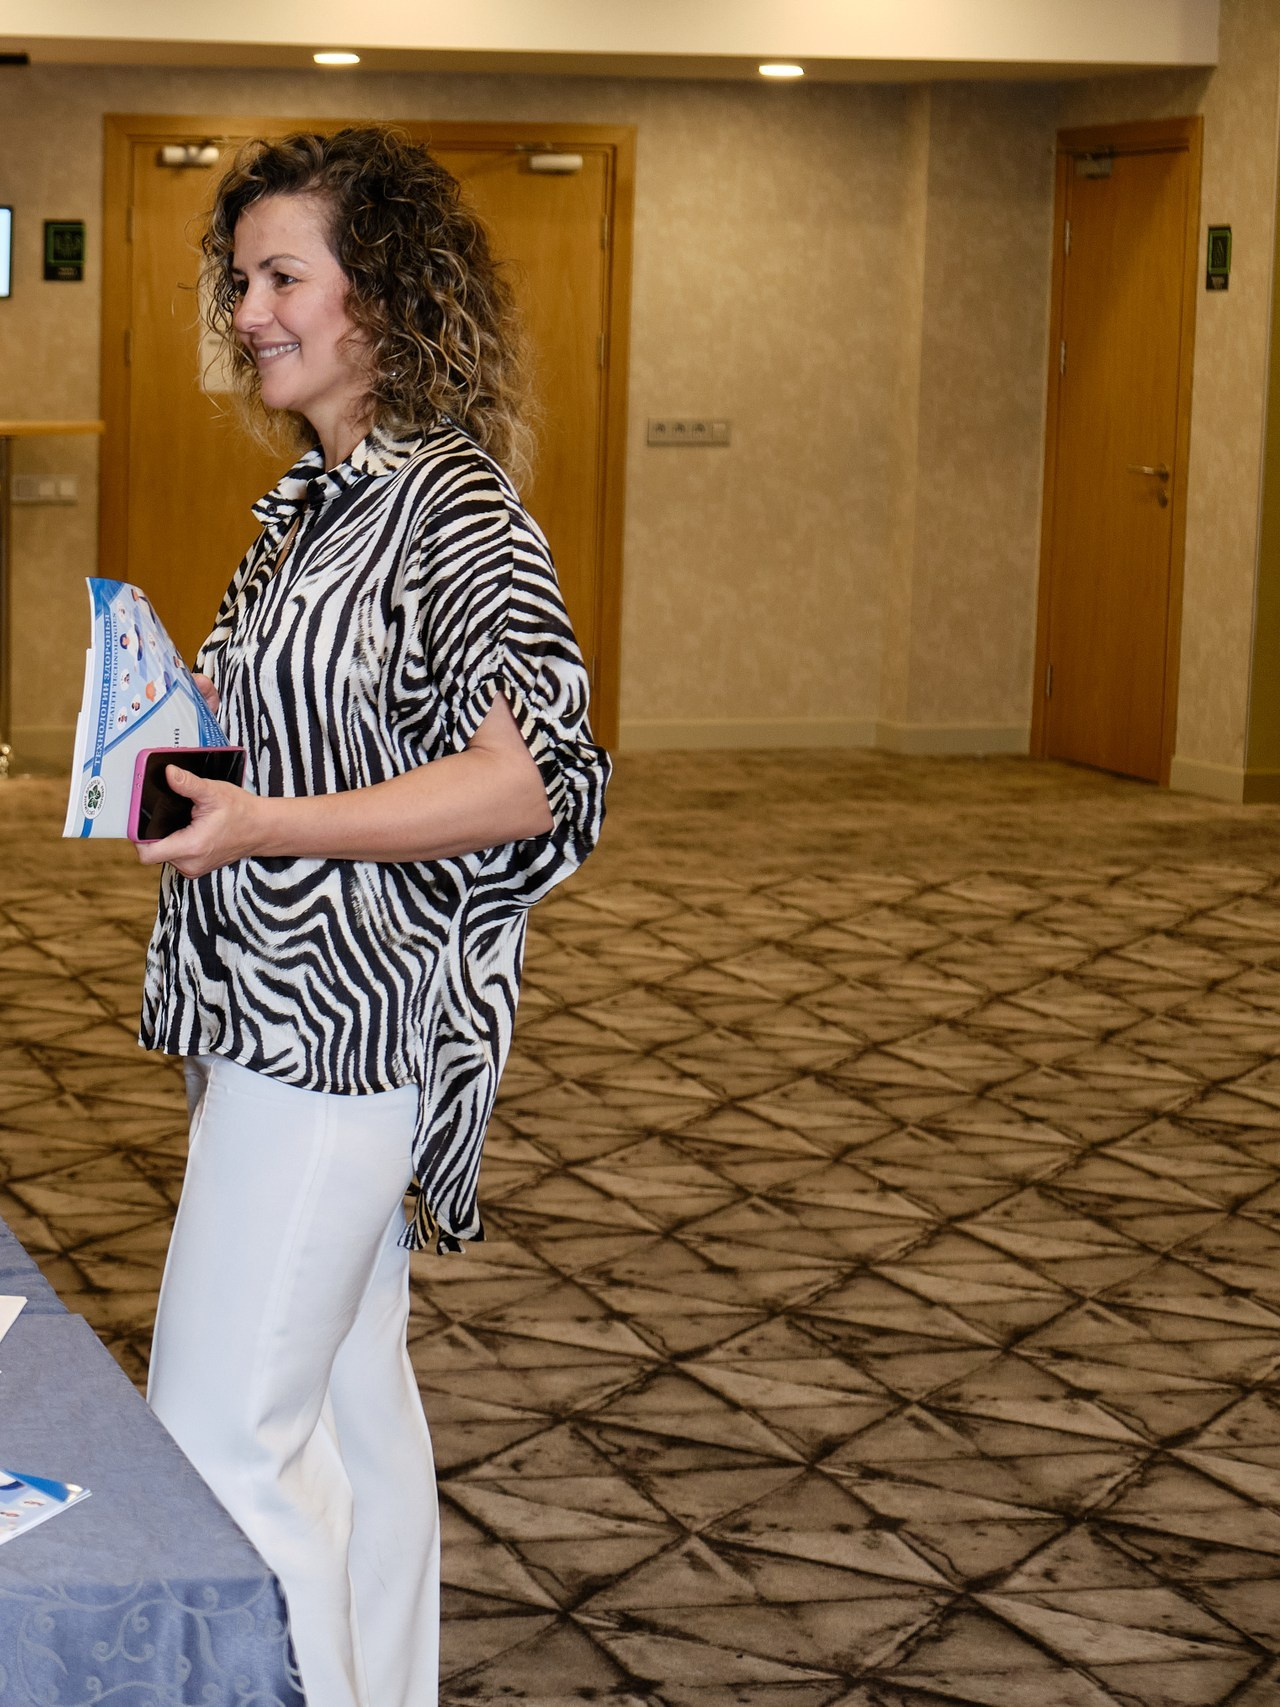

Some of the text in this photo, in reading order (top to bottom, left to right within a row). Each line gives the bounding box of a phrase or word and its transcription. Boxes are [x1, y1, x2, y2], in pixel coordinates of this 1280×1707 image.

[94, 613, 112, 767] ТЕХНОЛОГИИ ЗДОРОВЬЯ
[108, 690, 117, 730] HEALTH
